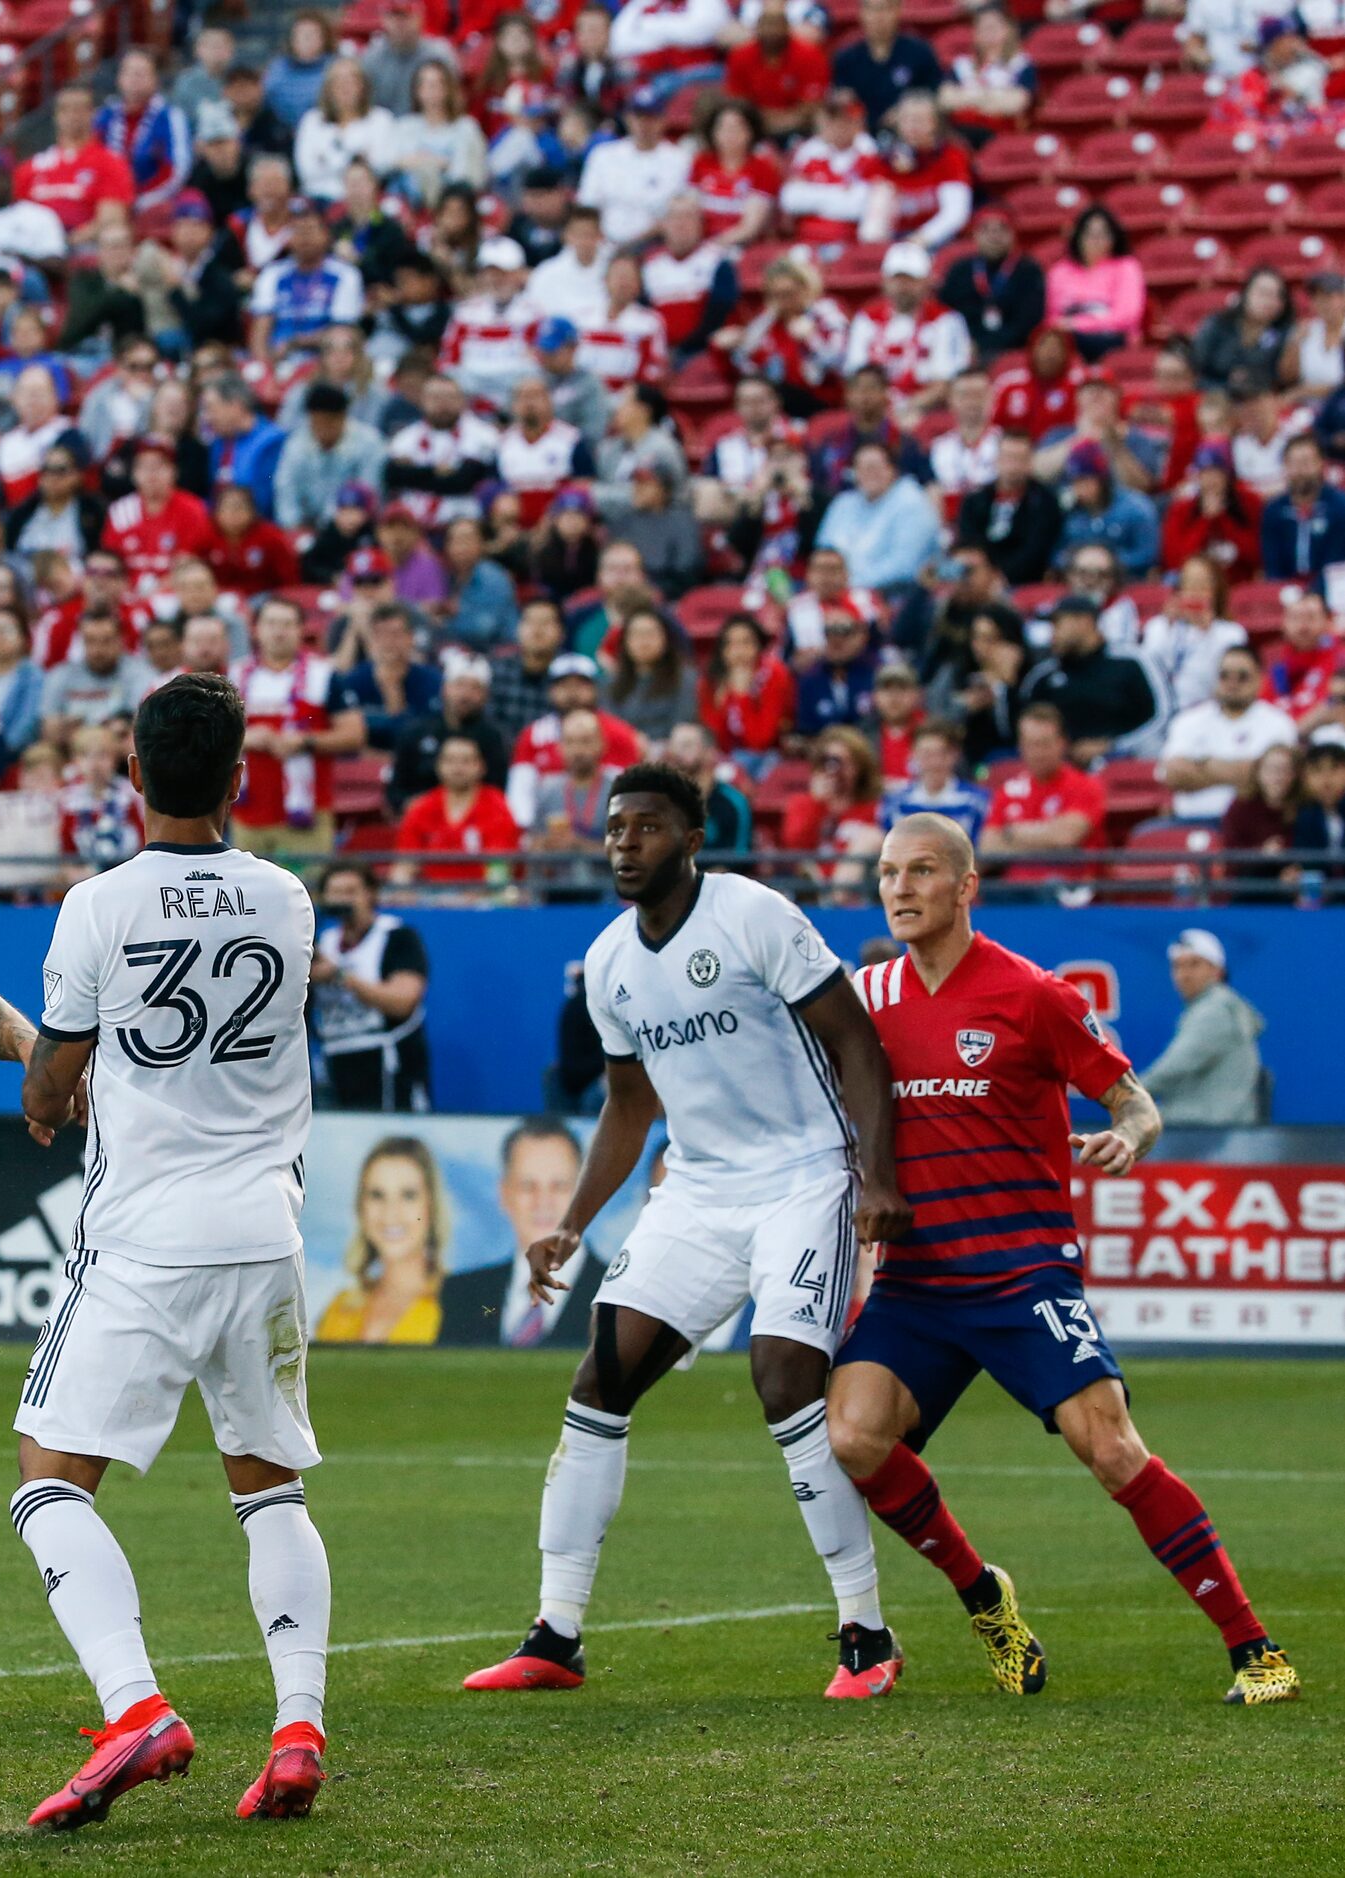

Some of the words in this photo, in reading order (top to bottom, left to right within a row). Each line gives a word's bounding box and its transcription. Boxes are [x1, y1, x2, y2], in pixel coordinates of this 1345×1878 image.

[159, 886, 257, 919] REAL
[116, 935, 285, 1069] 32
[1070, 1178, 1345, 1232] EXAS
[789, 1248, 828, 1305] 4
[1078, 1233, 1345, 1282] EATHE
[1032, 1297, 1098, 1342] 13
[1096, 1303, 1345, 1327] PERT
